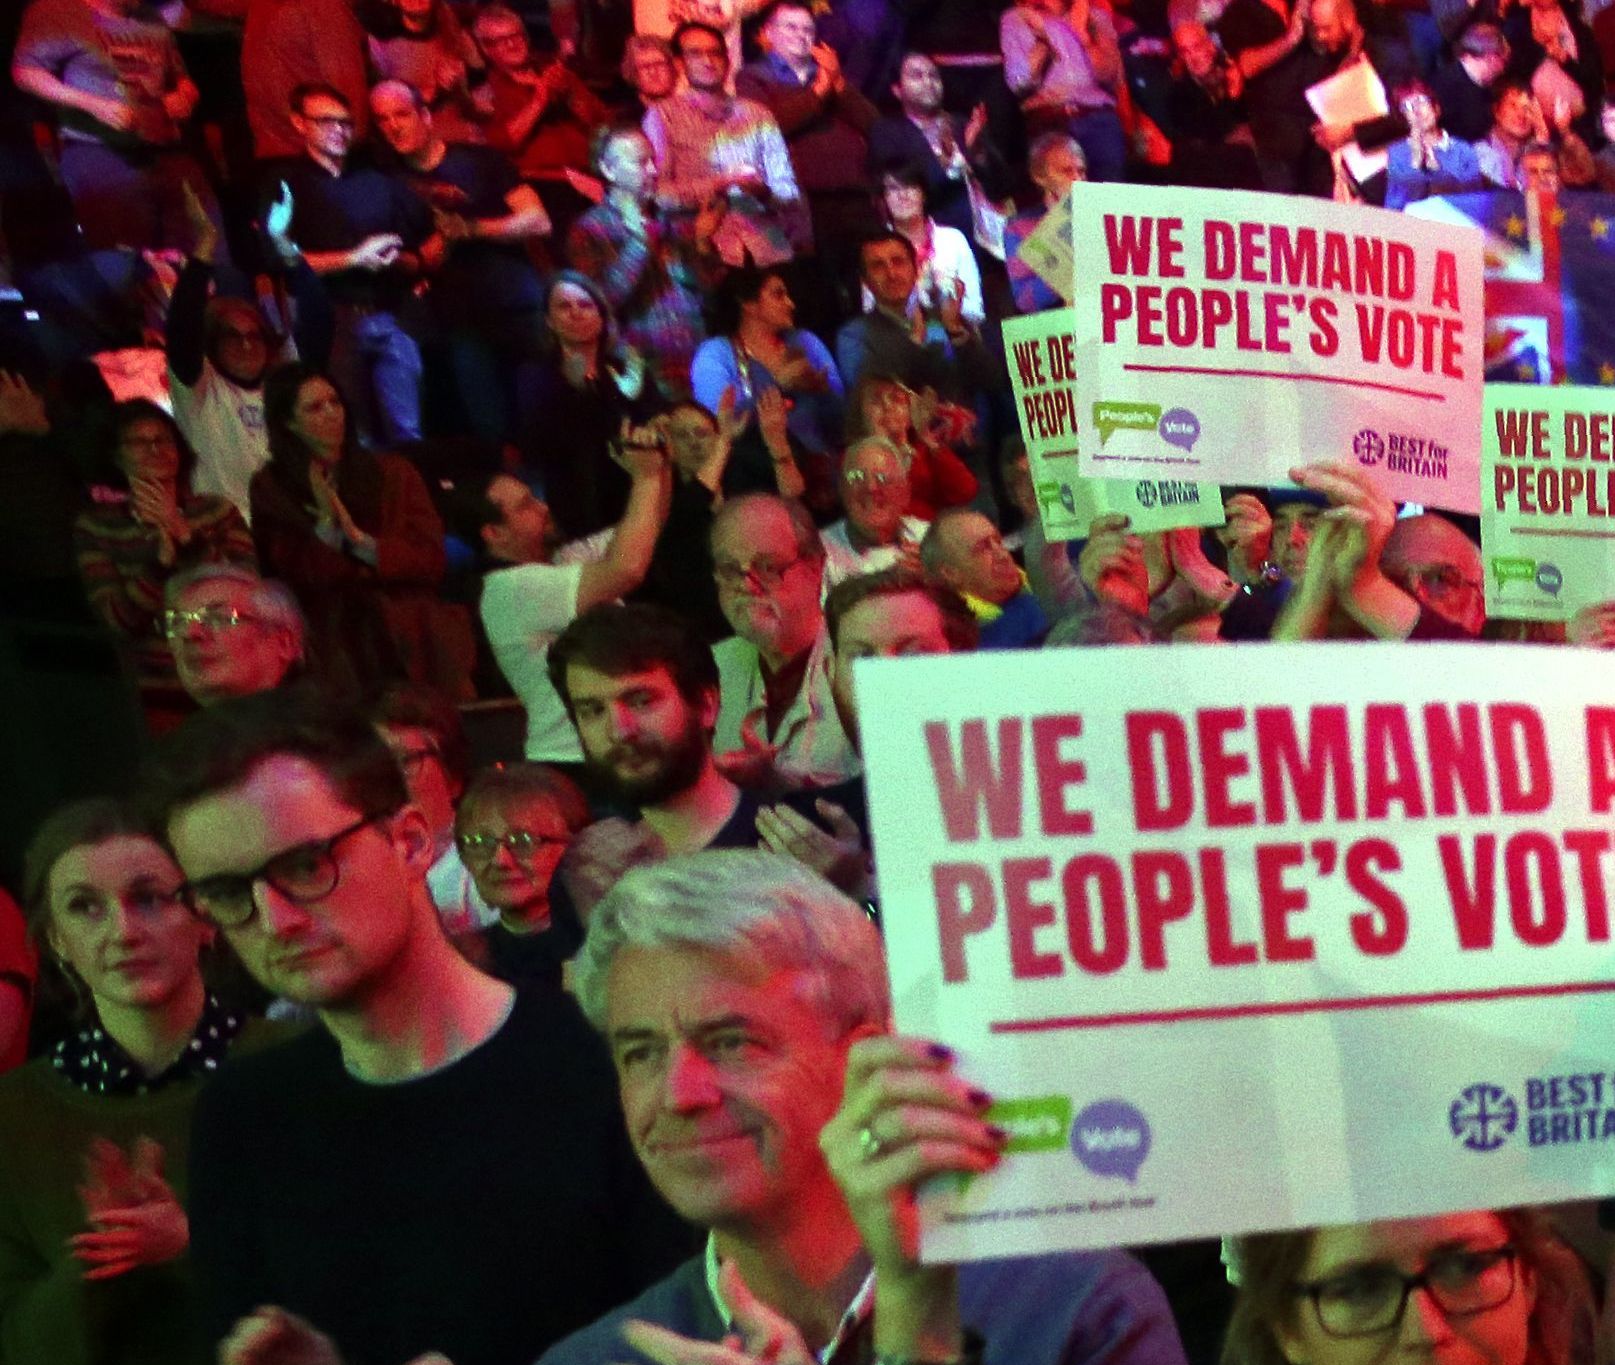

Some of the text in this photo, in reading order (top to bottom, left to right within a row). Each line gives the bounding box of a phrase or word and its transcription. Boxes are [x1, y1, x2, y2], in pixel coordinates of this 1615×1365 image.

[1103, 214, 1461, 313] WE DEMAND A
[1101, 283, 1463, 380] PEOPLE'S VOTE
[1013, 340, 1046, 389] WE
[1165, 421, 1196, 435] Vote
[1388, 434, 1427, 459] BEST
[1495, 408, 1551, 459] WE
[1386, 454, 1449, 479] BRITAIN
[925, 713, 1094, 844] WE
[1126, 702, 1552, 833] DEMAND
[931, 837, 1410, 984] PEOPLE'S
[1526, 1072, 1606, 1111] BEST
